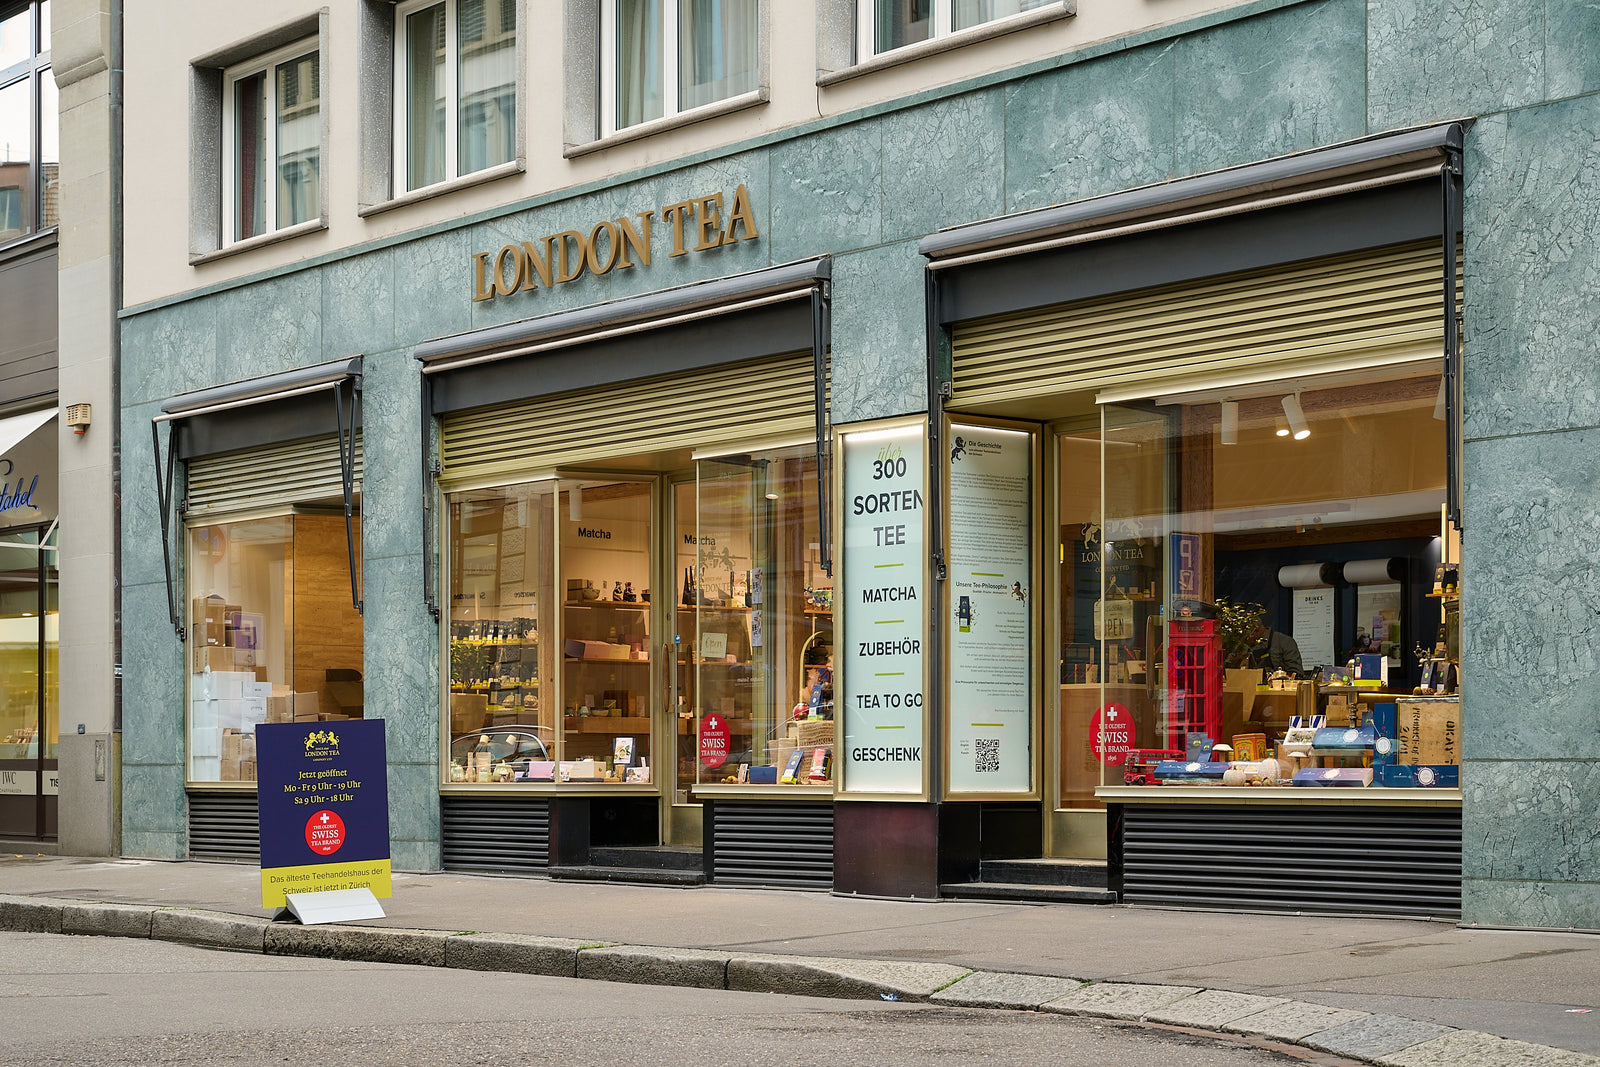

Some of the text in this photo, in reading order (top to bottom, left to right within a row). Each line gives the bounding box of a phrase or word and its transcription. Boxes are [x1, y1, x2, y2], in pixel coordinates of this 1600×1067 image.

[471, 184, 759, 302] LONDON TEA
[877, 443, 902, 462] über
[872, 458, 906, 480] 300
[0, 460, 39, 512] tahel
[853, 490, 923, 515] SORTEN
[578, 527, 611, 539] Matcha
[684, 534, 715, 545] Macha
[873, 525, 906, 546] TEE
[1082, 548, 1143, 563] LONON TEA
[863, 586, 916, 603] MATCHA
[859, 637, 920, 657] ZUBEHÖR
[856, 693, 922, 708] TEA TO GO
[702, 738, 725, 748] SWISS
[1097, 732, 1128, 743] SWISS
[853, 747, 921, 762] GESCHENK
[2, 771, 16, 784] IWC
[298, 769, 347, 780] Jetzt geöffnet
[284, 784, 297, 793] Mo
[312, 784, 317, 792] 9
[317, 782, 332, 790] Uhr
[338, 782, 346, 790] 19
[347, 780, 361, 789] Uhr
[294, 797, 303, 805] Sa
[310, 795, 325, 804] Uhr
[339, 793, 354, 801] Uhr
[312, 830, 339, 840] SWISS
[270, 875, 284, 883] Das
[286, 873, 310, 882] älteste
[312, 869, 370, 880] Teehandelshaus
[282, 887, 312, 895] Schweiz
[349, 881, 371, 889] Zürich
